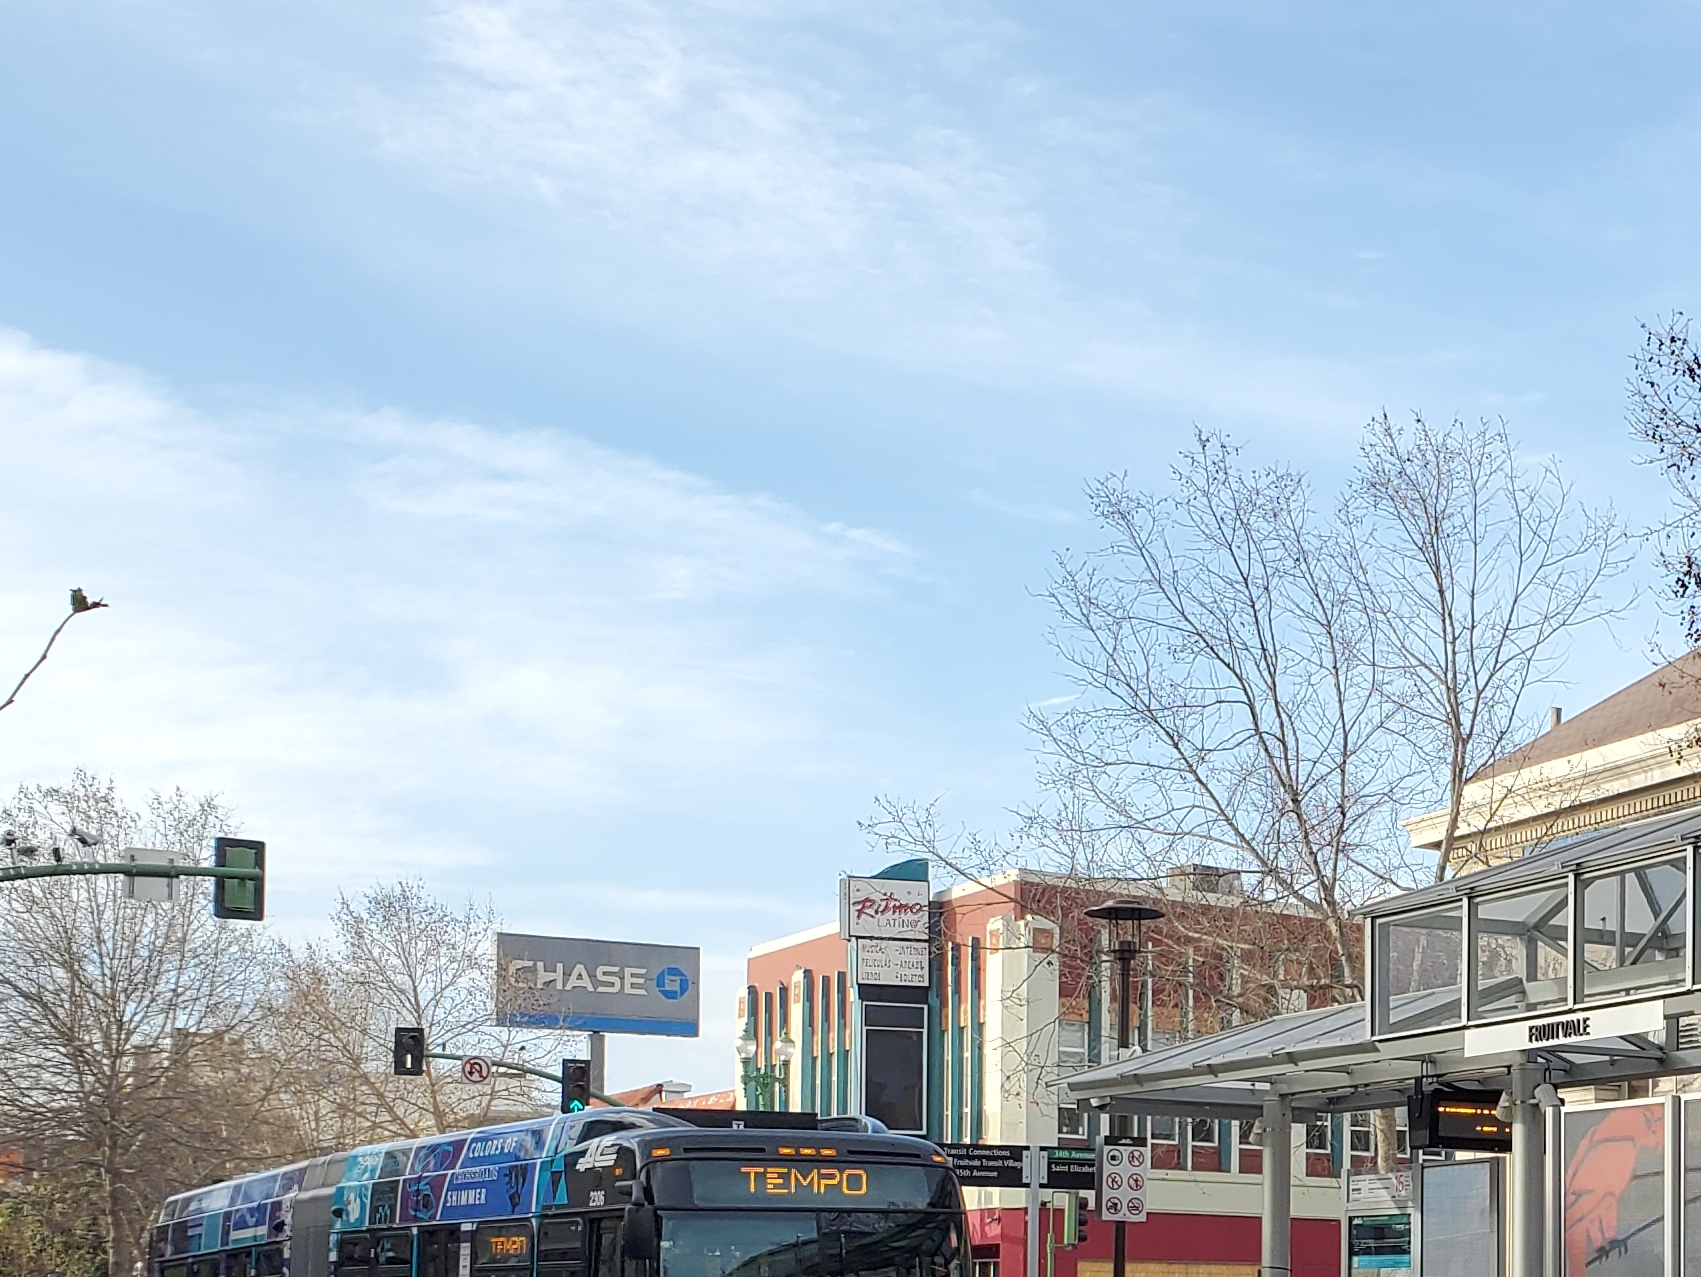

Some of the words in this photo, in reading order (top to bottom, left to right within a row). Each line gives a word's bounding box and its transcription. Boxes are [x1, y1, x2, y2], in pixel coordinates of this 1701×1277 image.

[852, 897, 923, 919] Ritmo
[877, 918, 919, 928] LATINO
[508, 960, 648, 996] CHASE
[1528, 1017, 1591, 1044] FRUITVALE
[469, 1140, 502, 1159] COLORS
[504, 1136, 518, 1153] OF
[968, 1148, 1011, 1157] Connections
[1054, 1150, 1070, 1159] 34th
[1004, 1160, 1023, 1170] Villag
[1051, 1163, 1069, 1173] Saint
[1070, 1164, 1097, 1174] Elizabet
[740, 1166, 868, 1195] TEMPO
[972, 1170, 998, 1178] Avenue
[445, 1188, 487, 1207] SHIMMER
[588, 1191, 605, 1207] 2306
